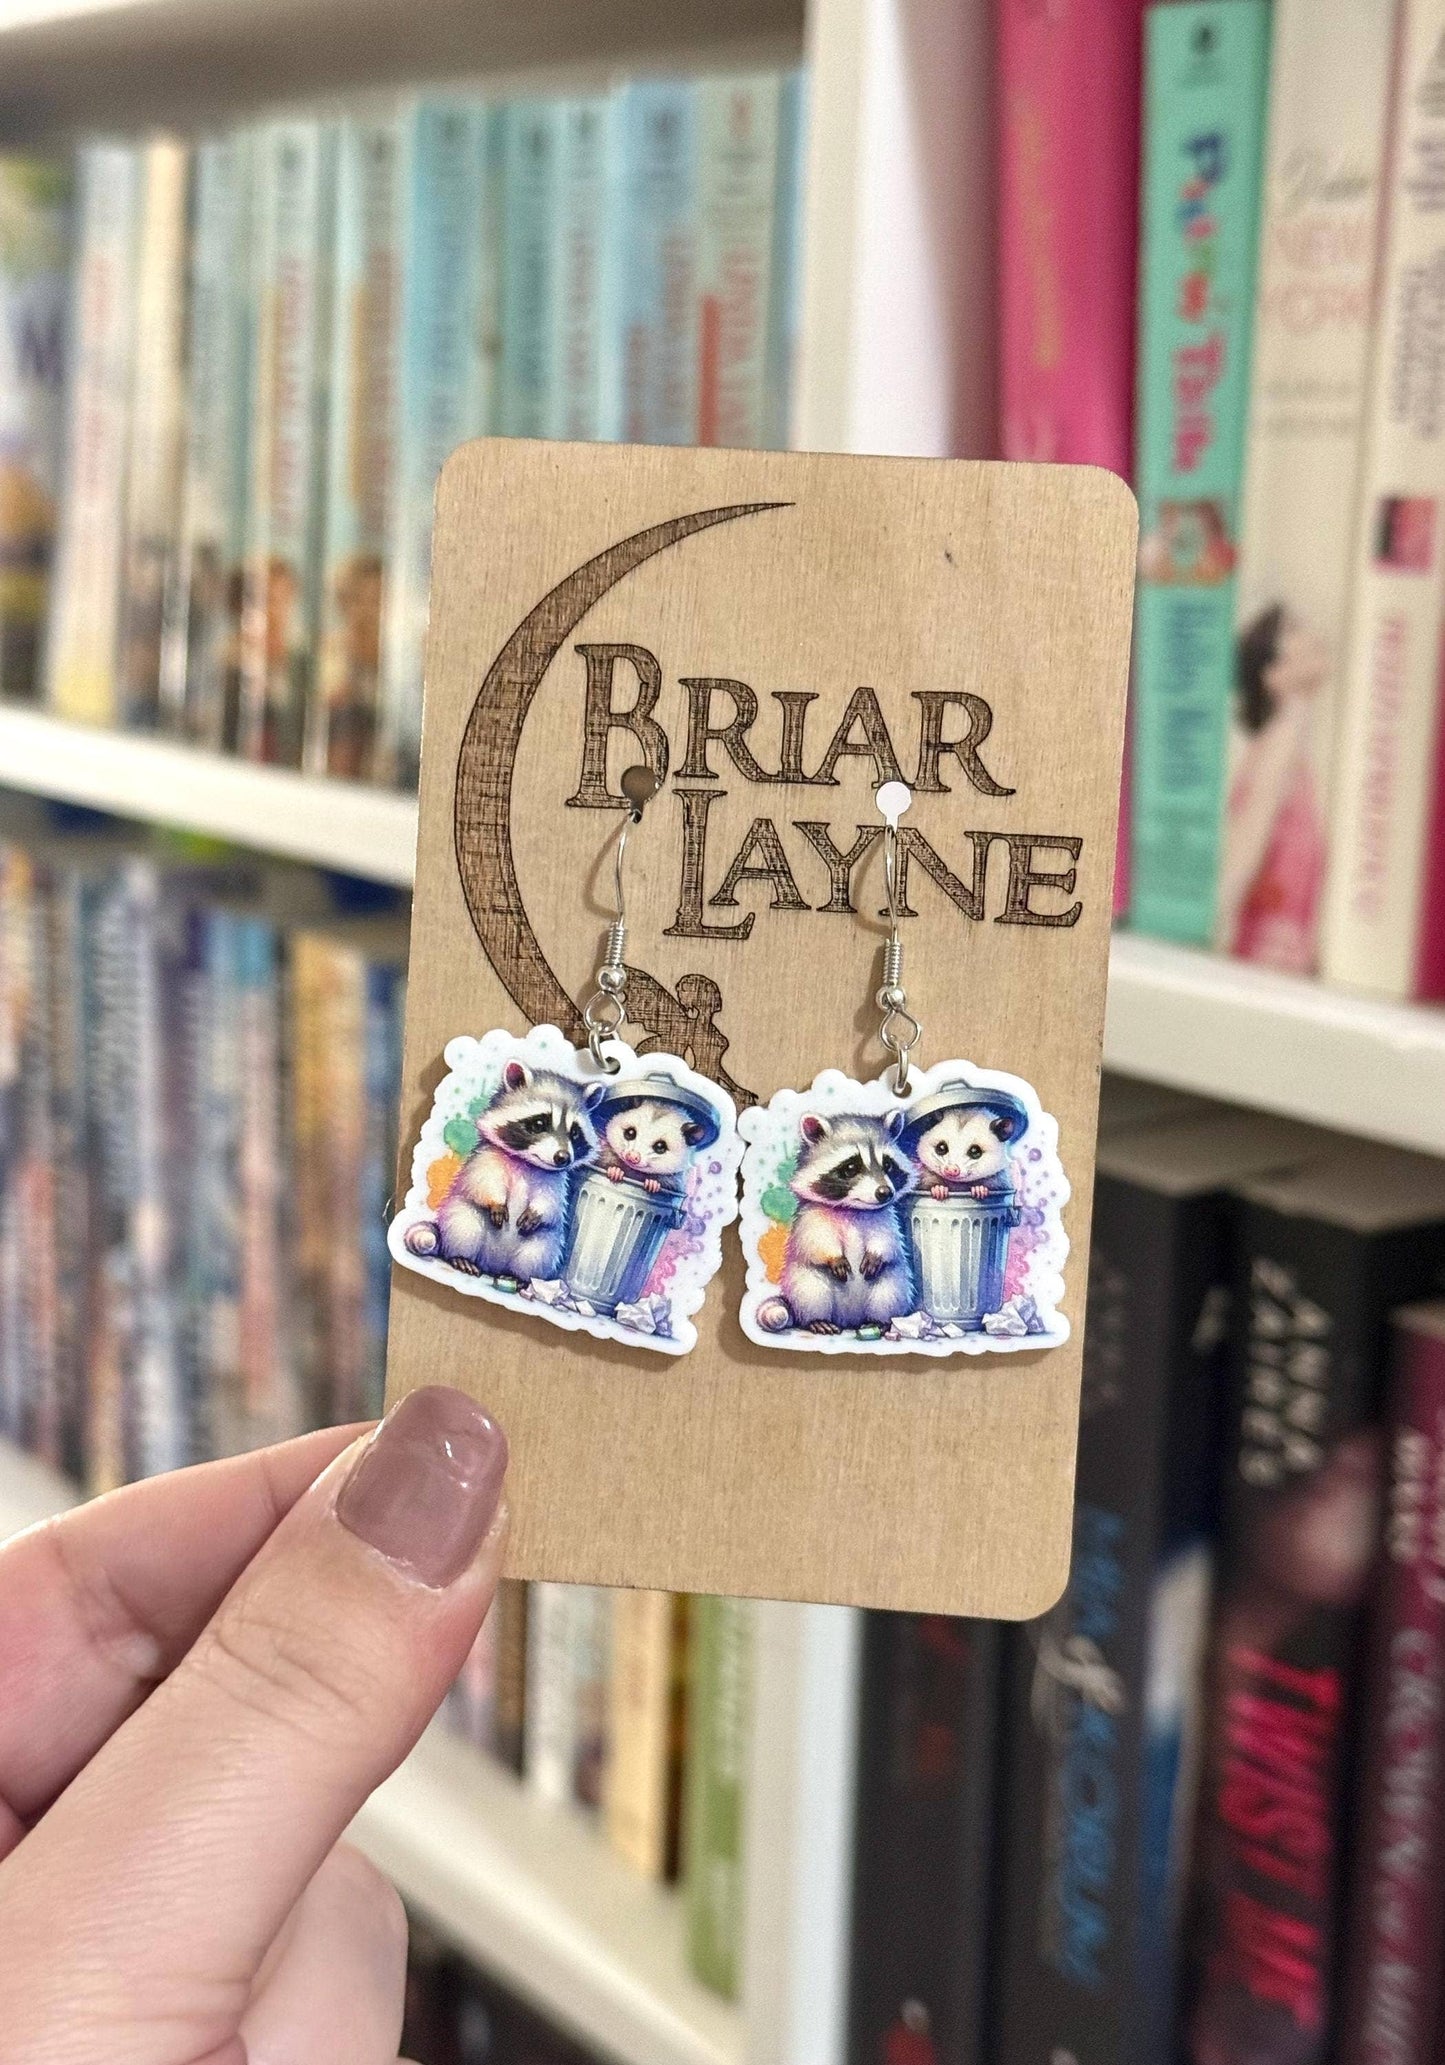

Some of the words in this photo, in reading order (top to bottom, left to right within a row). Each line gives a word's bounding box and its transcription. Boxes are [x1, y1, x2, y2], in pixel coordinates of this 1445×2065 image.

[565, 643, 1016, 809] BRIAR
[663, 789, 1083, 940] LAYNE
[1219, 1642, 1341, 1895] TWIST
